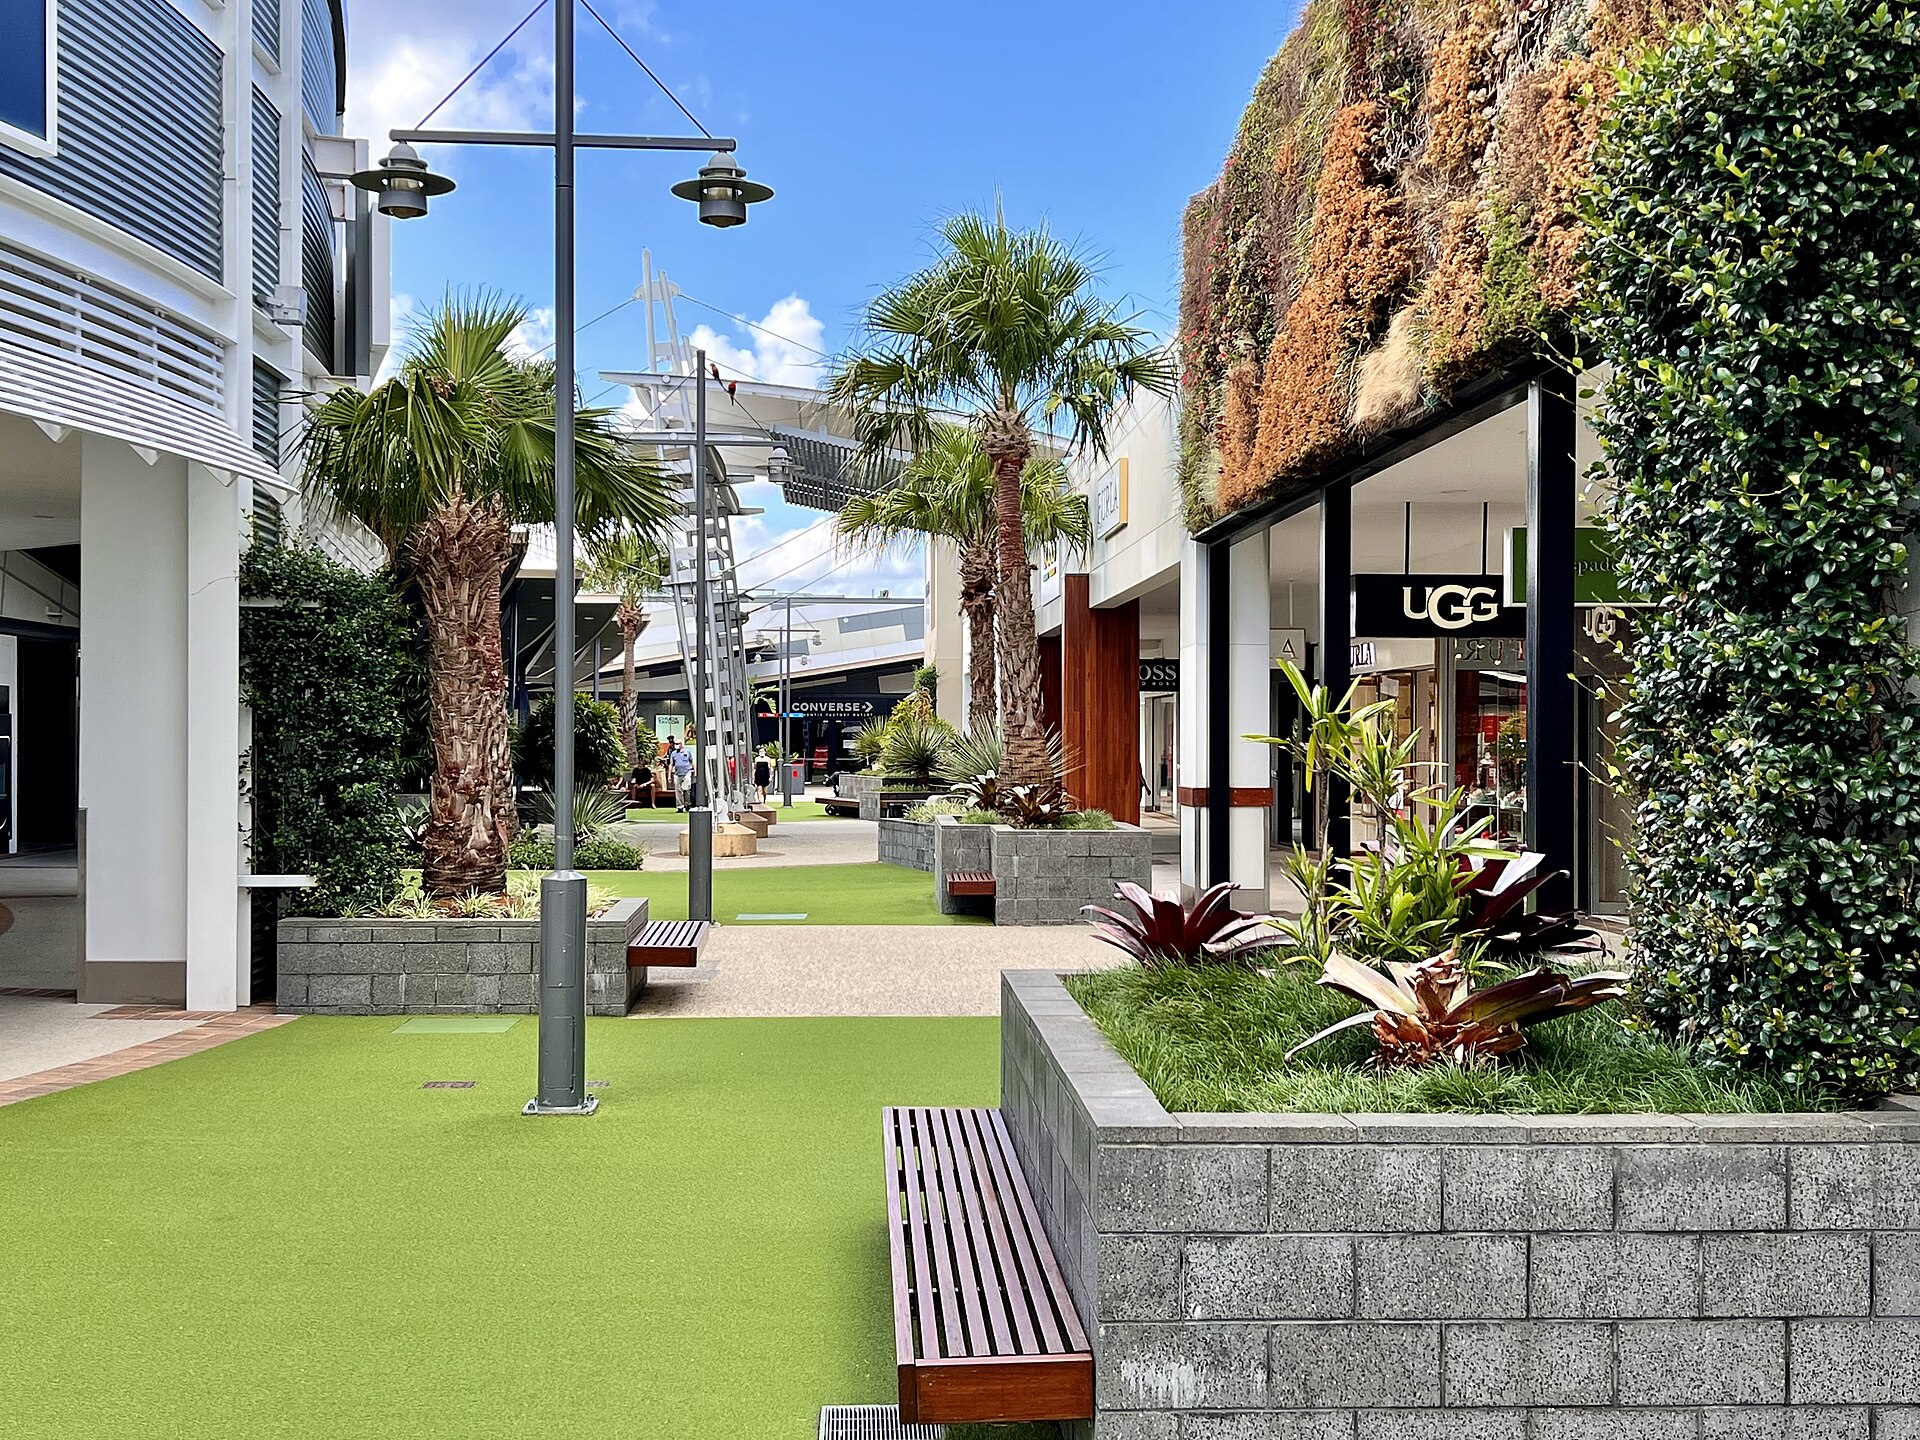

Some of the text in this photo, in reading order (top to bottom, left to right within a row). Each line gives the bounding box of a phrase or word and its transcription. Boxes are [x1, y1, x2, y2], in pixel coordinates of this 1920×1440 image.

[1097, 478, 1118, 525] FURLA
[1402, 584, 1499, 629] UGG
[1584, 606, 1616, 644] UGG
[1139, 664, 1177, 680] OSS
[791, 702, 860, 712] CONVERSE
